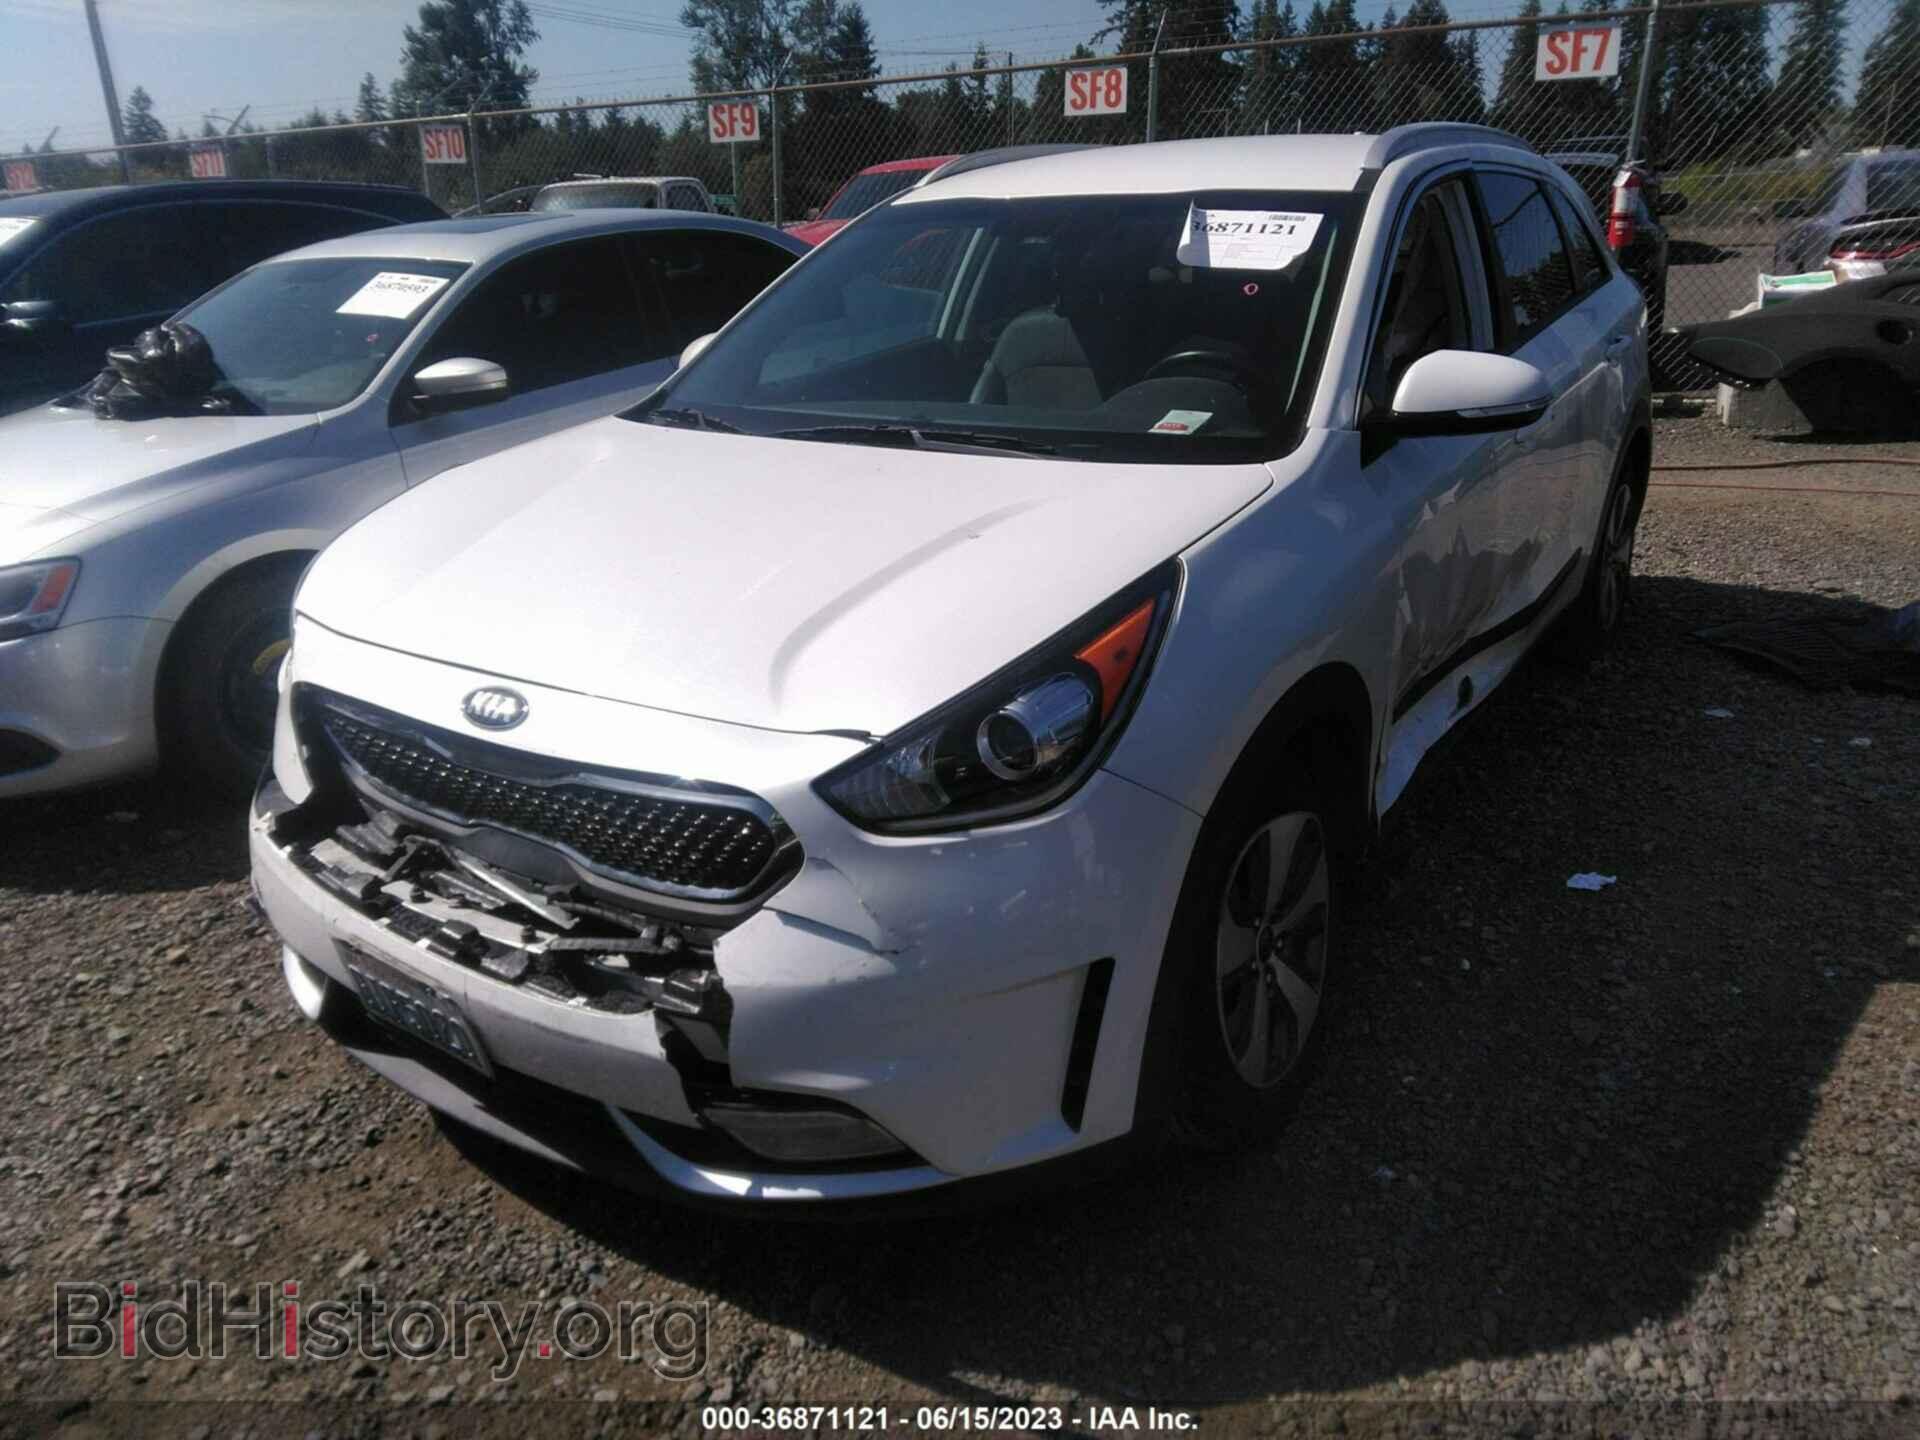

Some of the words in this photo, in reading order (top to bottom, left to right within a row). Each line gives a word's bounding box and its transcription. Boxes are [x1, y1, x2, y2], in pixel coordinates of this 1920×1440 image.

[1545, 27, 1612, 75] SF7
[1070, 67, 1122, 111] SF8
[711, 101, 755, 138] SF9
[424, 128, 464, 159] SF10
[1190, 220, 1297, 235] 36871121
